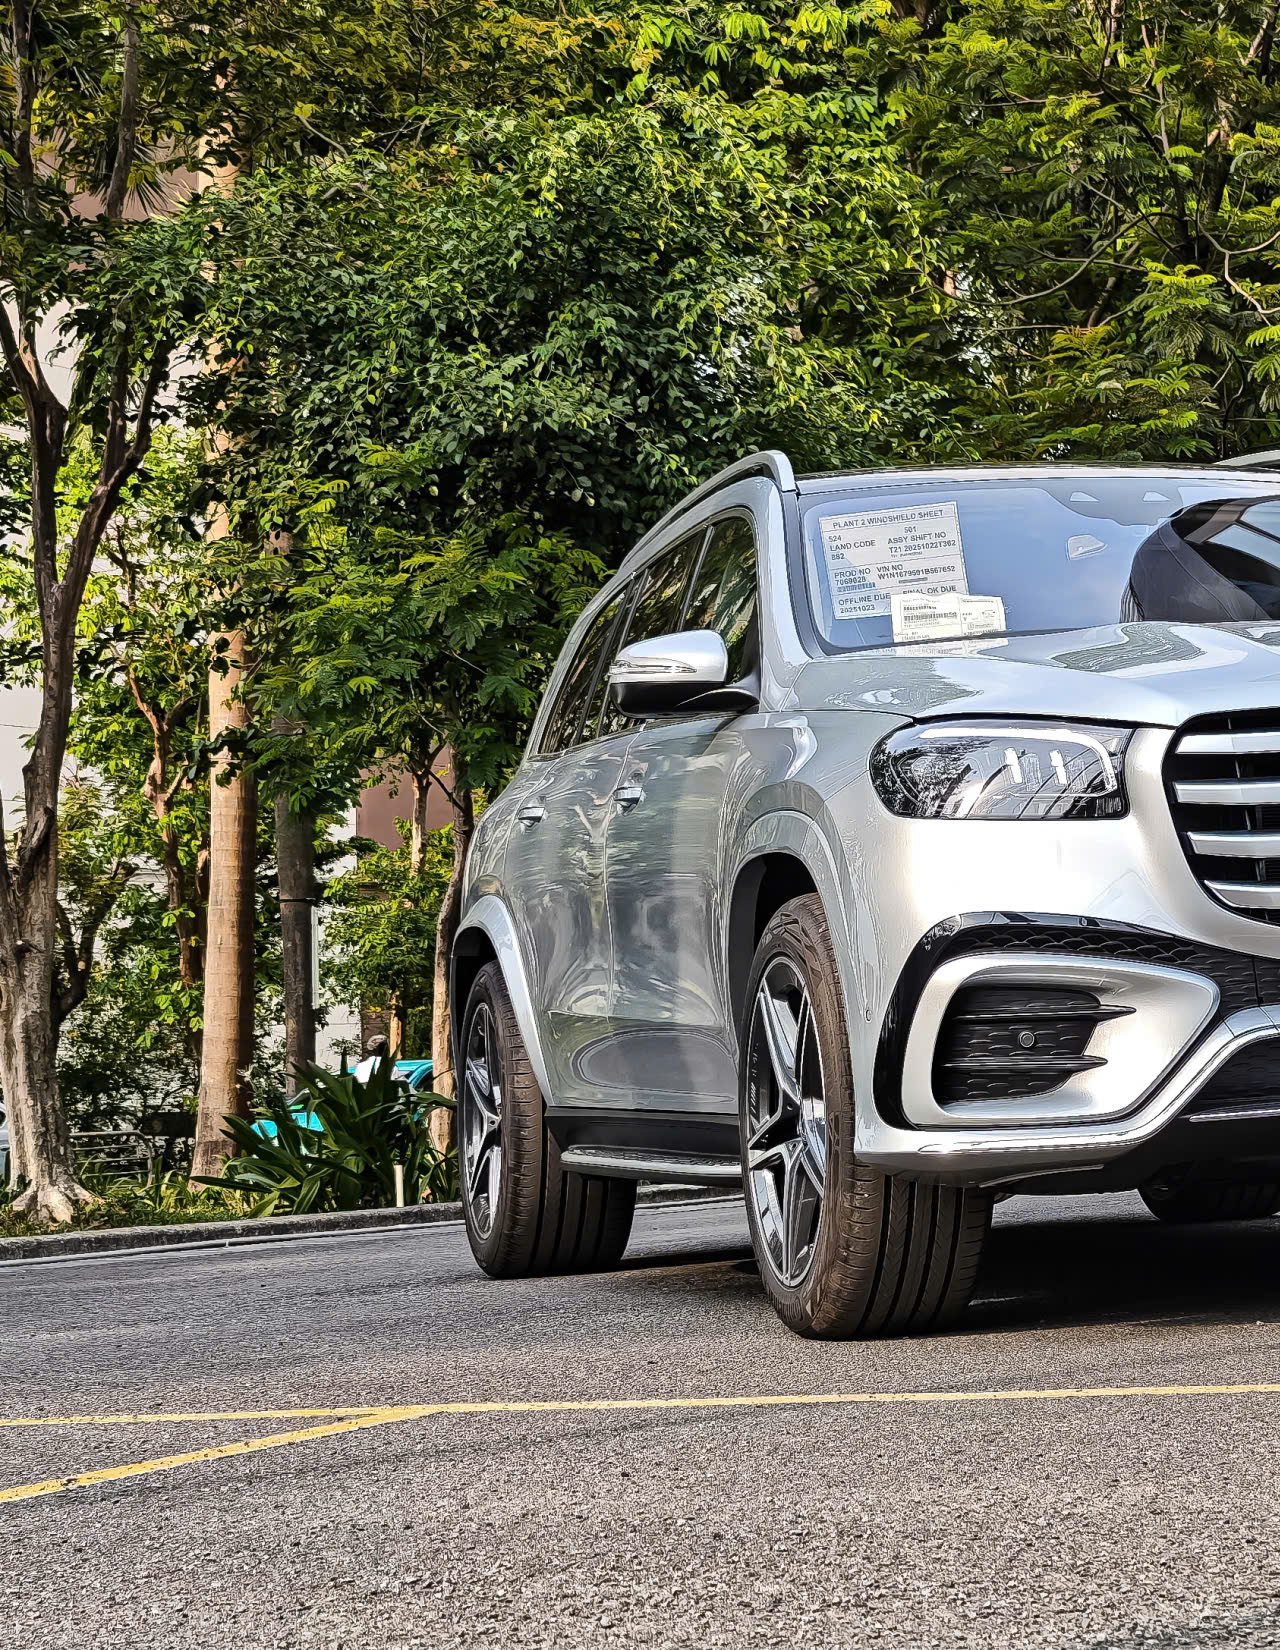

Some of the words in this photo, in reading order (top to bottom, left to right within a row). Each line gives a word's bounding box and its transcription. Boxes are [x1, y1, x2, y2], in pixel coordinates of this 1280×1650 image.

[833, 519, 858, 529] PLANT
[861, 518, 866, 526] 2
[867, 513, 916, 525] WINDSHIELD
[918, 510, 944, 518] SHEET
[888, 536, 908, 545] ASSY
[911, 533, 933, 542] SHIFT
[934, 531, 947, 539] NO
[830, 543, 851, 551] LAND
[854, 540, 876, 548] CODE
[834, 570, 856, 579] PROD
[940, 585, 956, 593] DUE
[839, 594, 872, 606] OFFLINE
[874, 592, 890, 601] DUE
